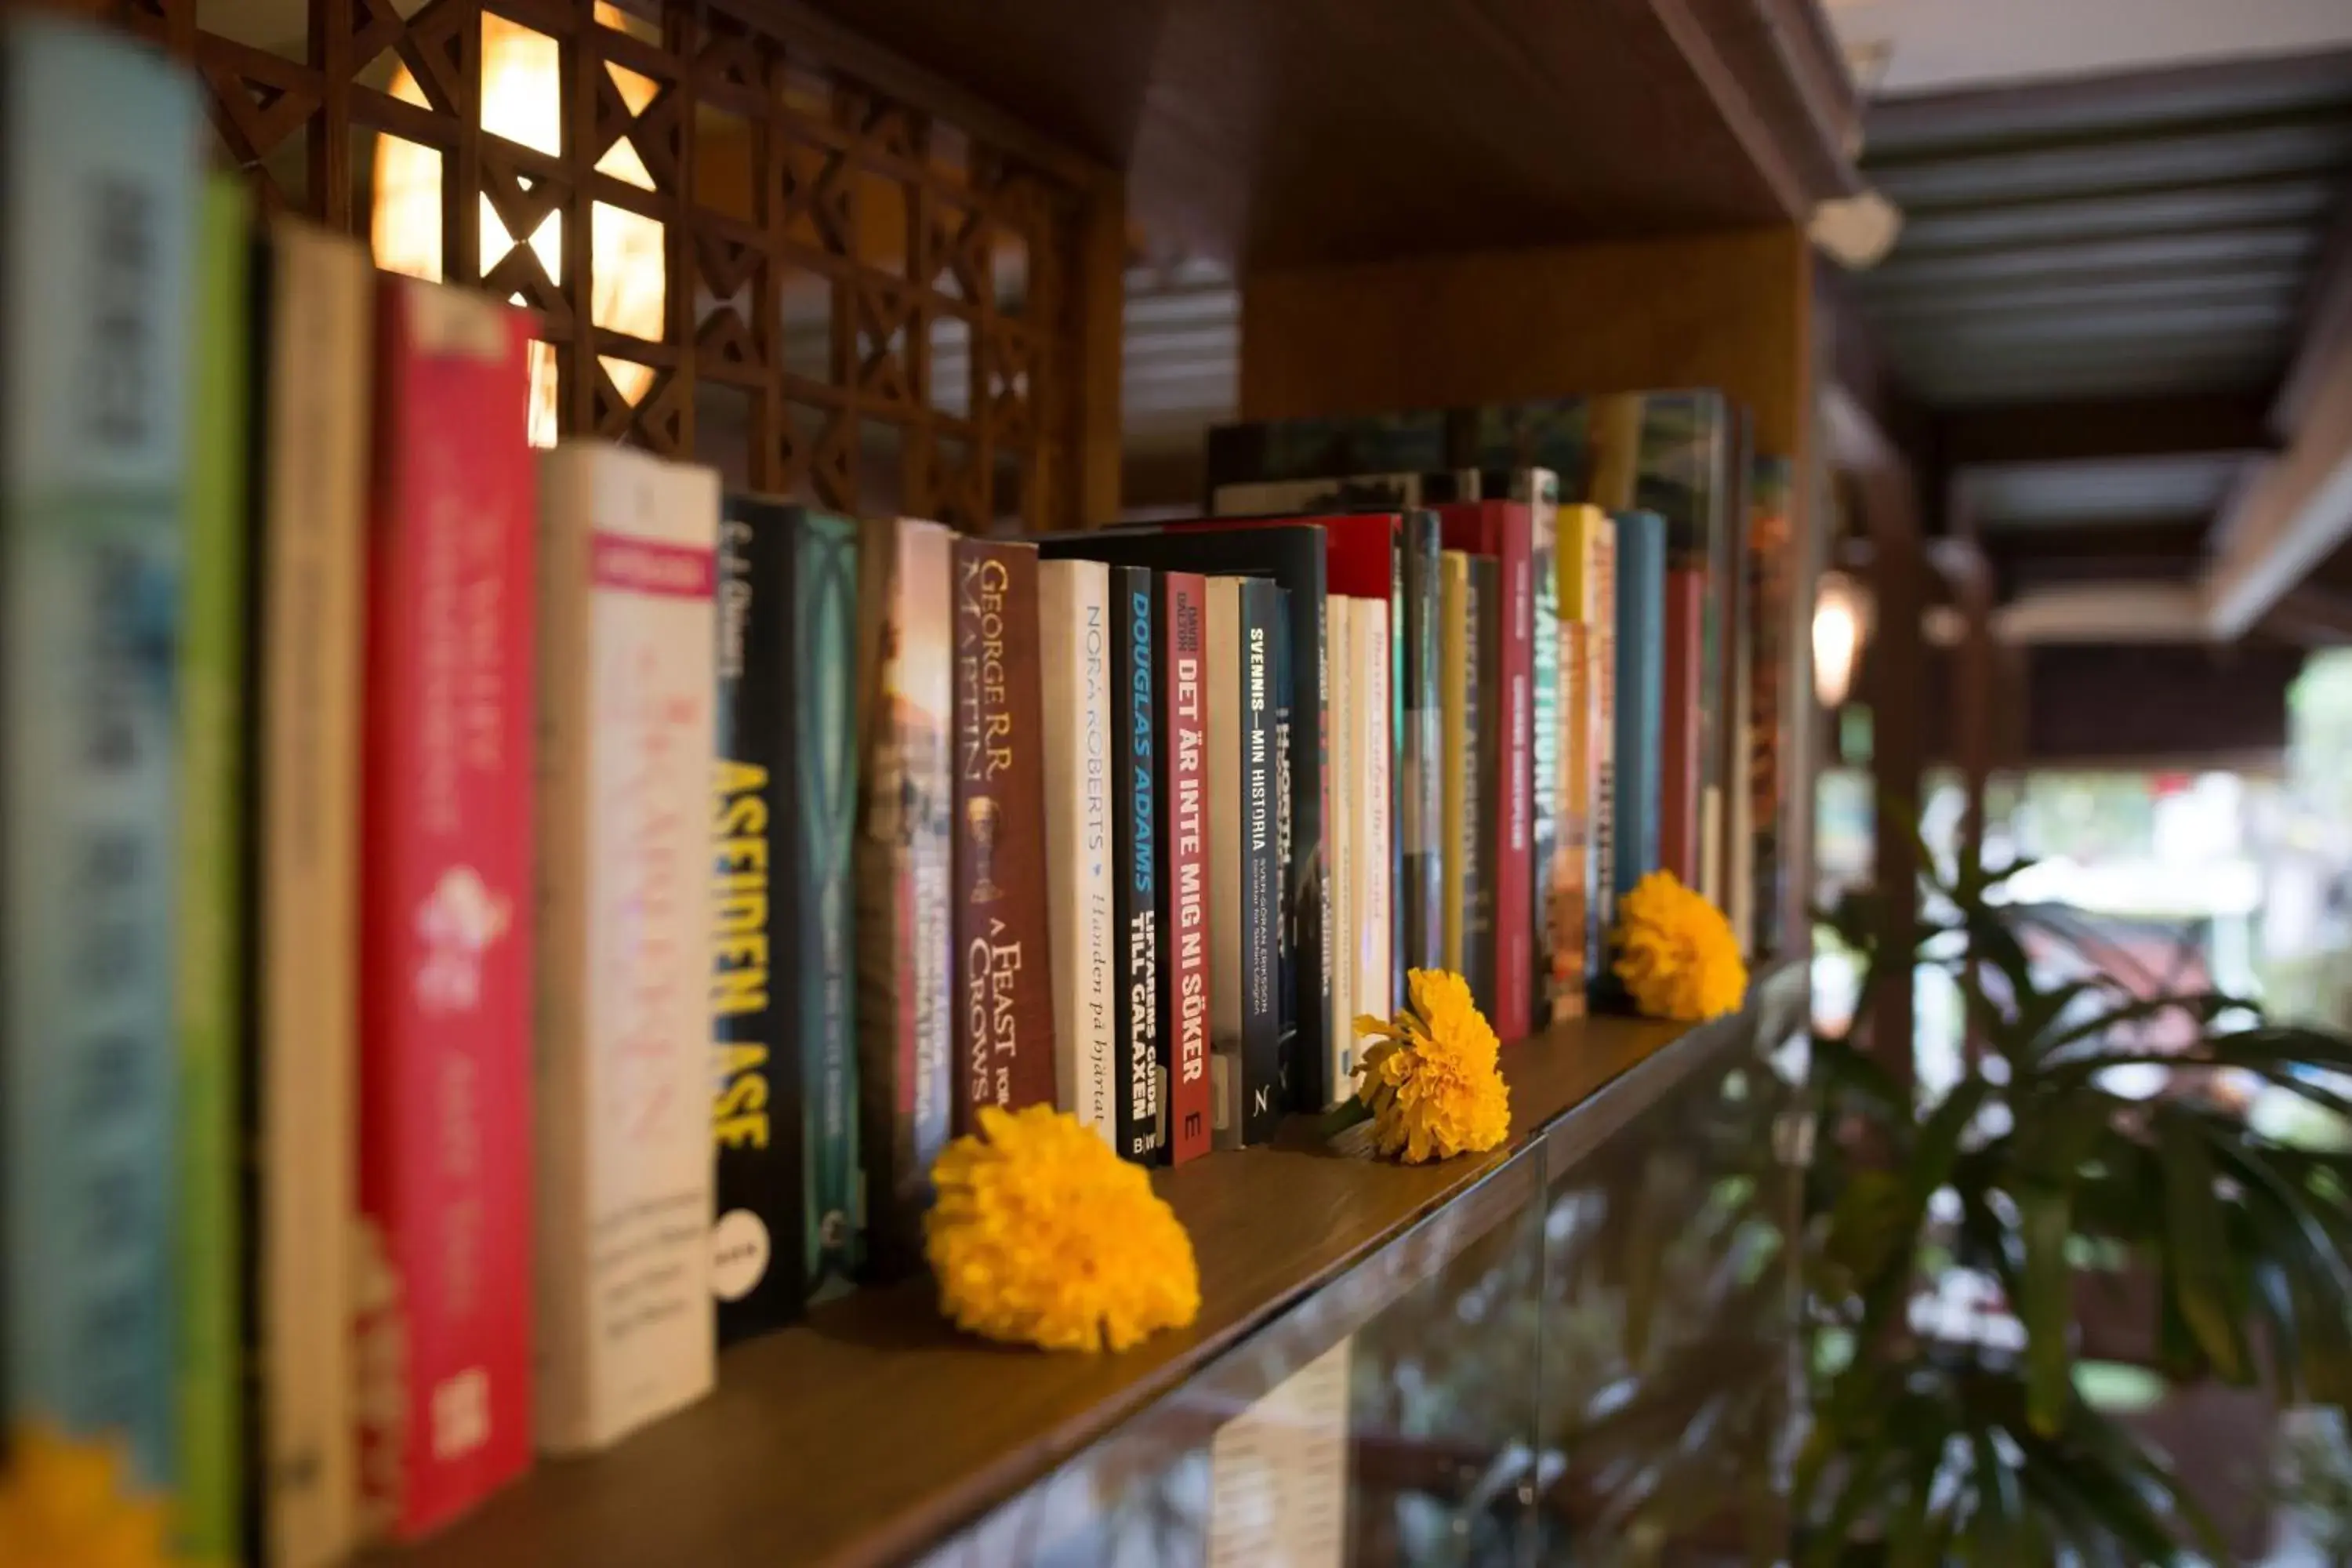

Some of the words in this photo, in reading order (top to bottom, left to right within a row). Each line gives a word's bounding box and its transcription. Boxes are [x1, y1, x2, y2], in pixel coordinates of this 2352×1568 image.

[960, 557, 982, 782] MARTIN
[980, 559, 1009, 705] GEORGE
[1086, 605, 1102, 700] NORA
[1132, 592, 1151, 757] DOUGLAS
[1178, 659, 1198, 722] DET
[1086, 709, 1104, 851] ROBERTS
[1179, 728, 1203, 772] ÄR
[1134, 768, 1154, 894] ADAMS
[1179, 779, 1200, 857] INTE
[1251, 769, 1266, 851] HISTORIA
[1131, 911, 1145, 976] TILL
[1180, 864, 1201, 929] MIG
[1181, 931, 1202, 969] NI
[968, 936, 992, 1102] CROWS
[991, 940, 1022, 1058] FEAST
[1145, 910, 1157, 1040] LIFTARENS
[1181, 972, 1207, 1083] SÖKER
[1131, 981, 1149, 1122] GALAXEN
[1146, 1044, 1158, 1117] GUIDE
